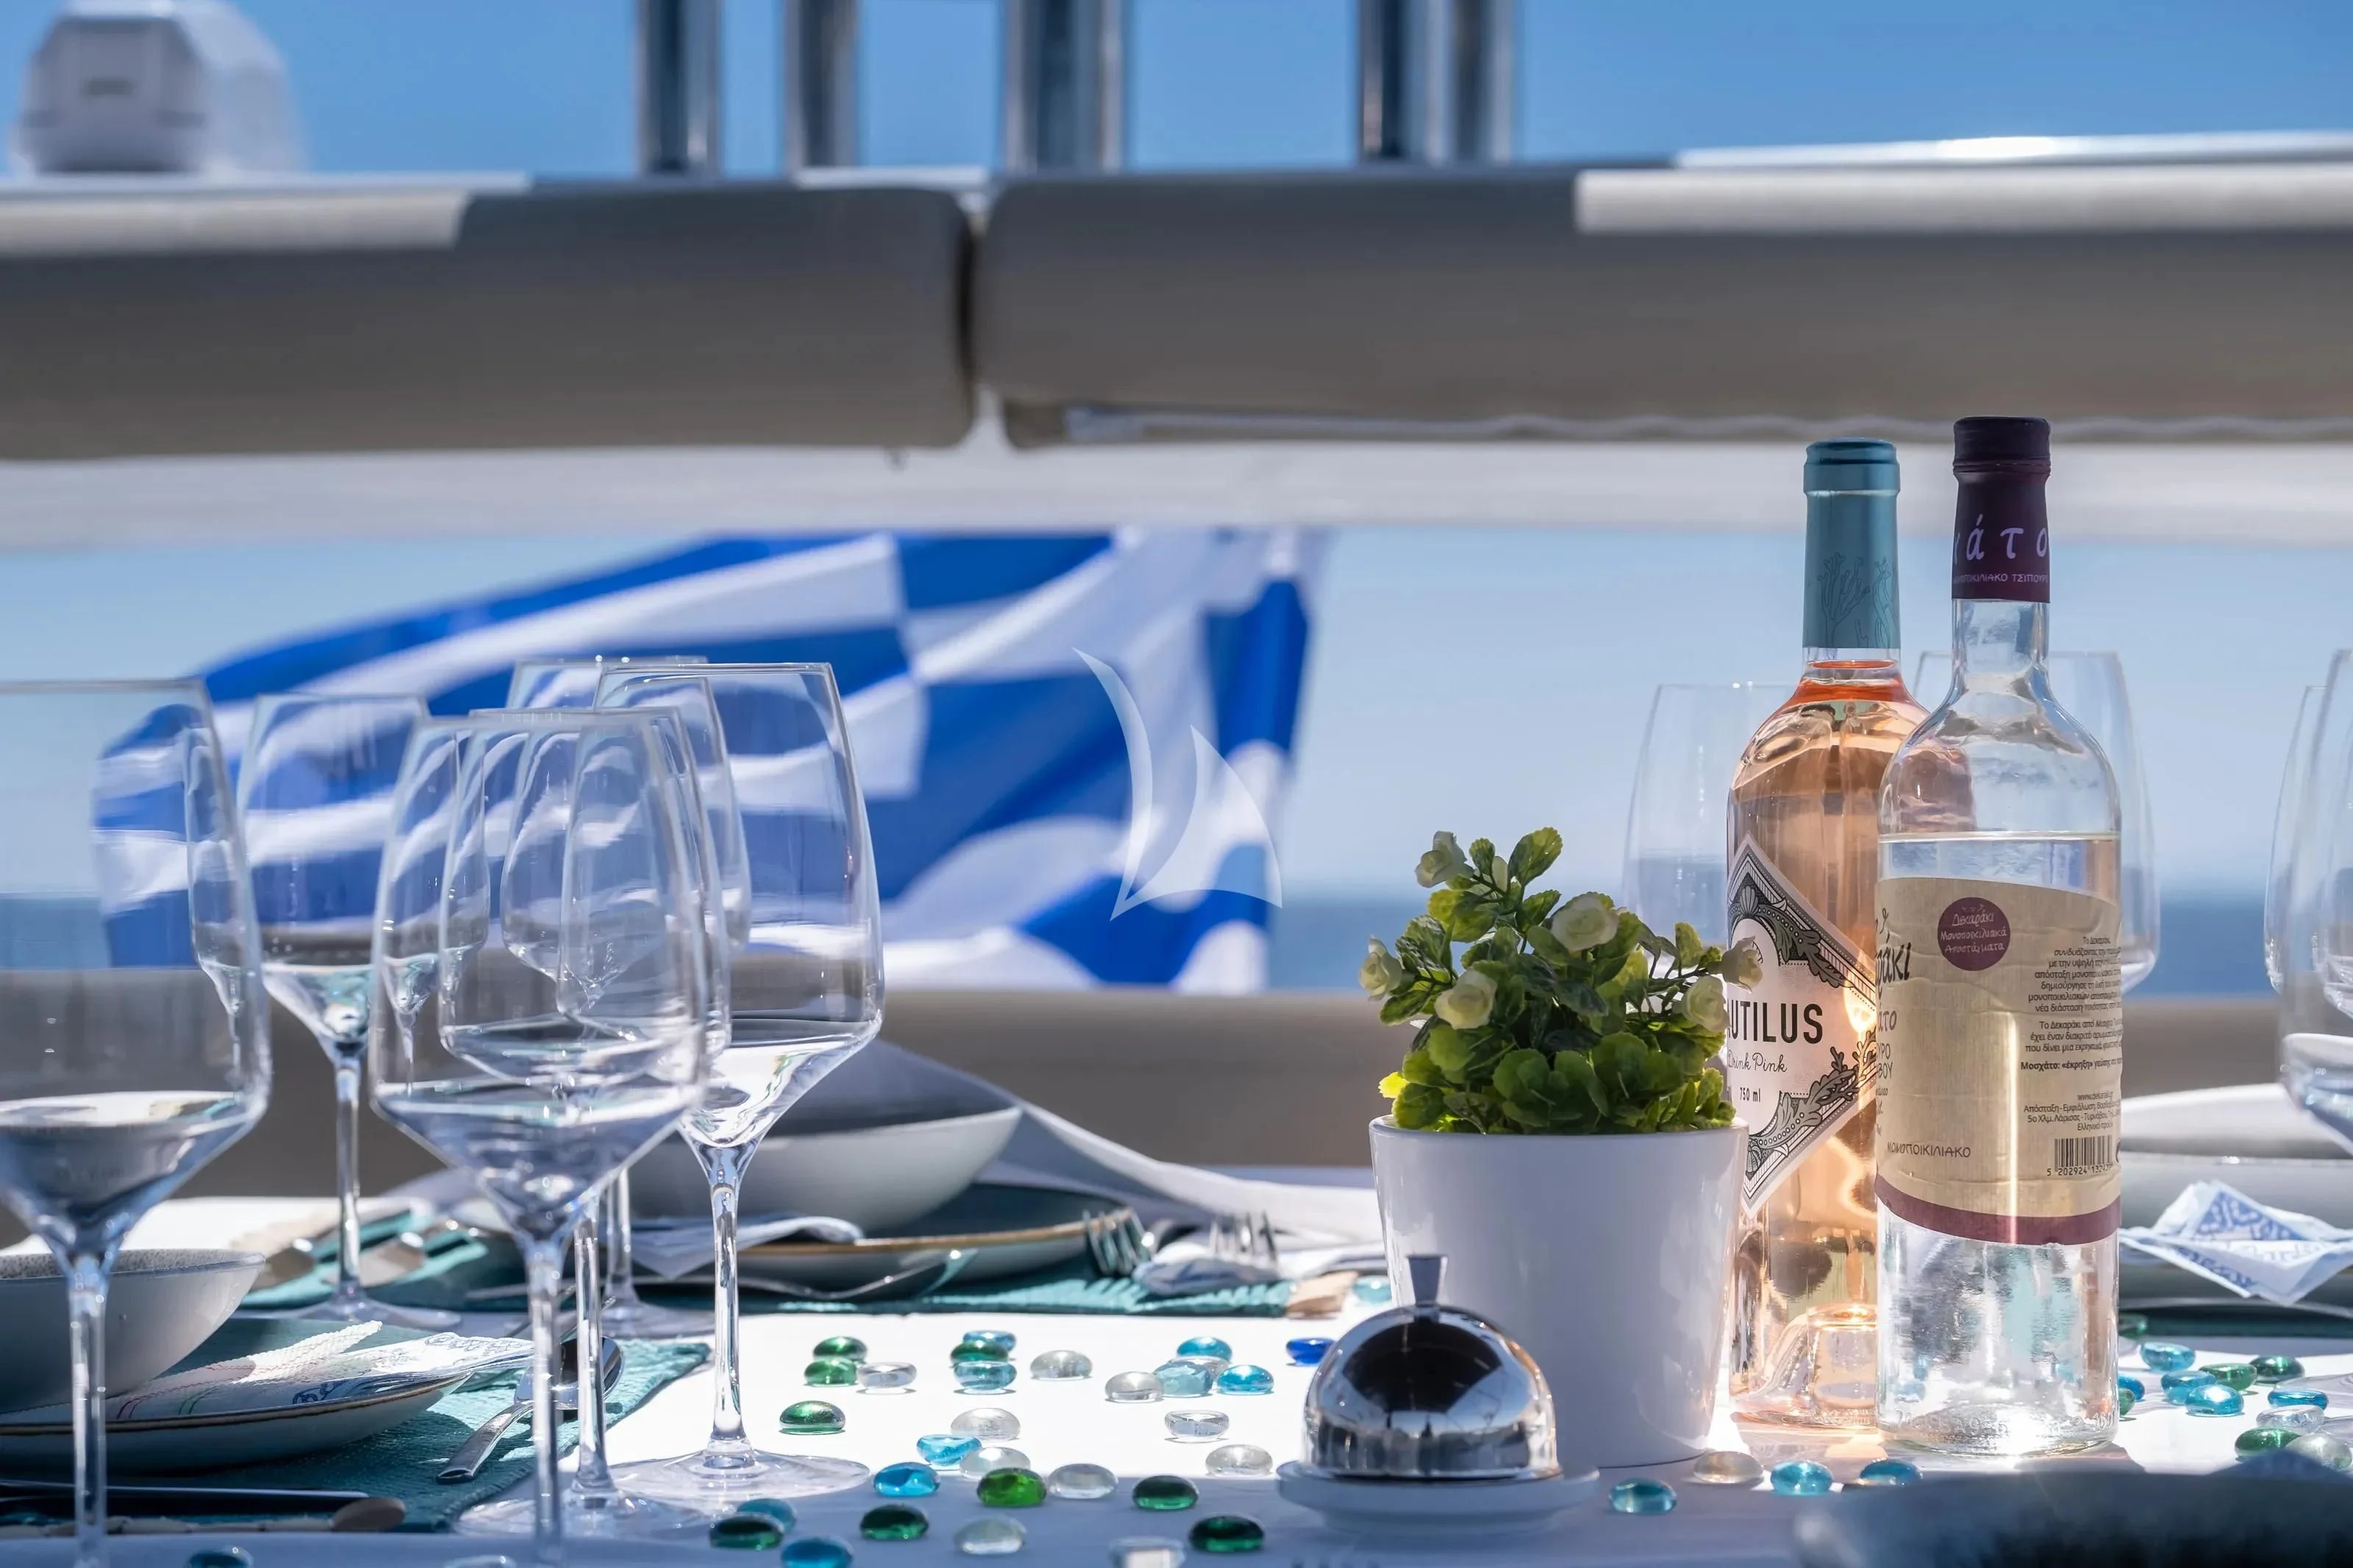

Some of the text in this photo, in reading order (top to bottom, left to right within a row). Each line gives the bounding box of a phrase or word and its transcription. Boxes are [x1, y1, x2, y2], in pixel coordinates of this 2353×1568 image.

[1952, 909, 1995, 926] Δεκαράκι
[1941, 926, 2007, 941] Μονοποικιλιακά
[1945, 942, 2004, 953] Αποστάγματα
[2049, 960, 2057, 968] με
[2058, 960, 2071, 968] την
[2072, 958, 2094, 968] υψηλή
[2035, 970, 2071, 980] απόσταξη
[2040, 981, 2087, 991] δημιούργησε
[2035, 1004, 2049, 1012] νέα
[2050, 1003, 2083, 1013] διάσταση
[2039, 1021, 2049, 1029] Το
[2051, 1020, 2081, 1030] Δεκαράκι
[2030, 1032, 2046, 1042] έχει
[2047, 1031, 2064, 1041] έναν
[2043, 1044, 2060, 1052] δίνει
[2062, 1045, 2074, 1053] μια
[1752, 1052, 1788, 1073] Pink
[2021, 1061, 2060, 1072] Μοσχάτο:
[2061, 1060, 2093, 1070] «έκρηξη»
[1740, 1087, 1750, 1100] 750
[1753, 1088, 1761, 1102] ml
[2024, 1104, 2059, 1113] Απόσταξη
[1887, 1141, 1971, 1158] ΜΟΝΟΠΟΙΚΙΛΙΑΚΟ
[2046, 1168, 2052, 1176] 5
[2058, 1167, 2087, 1176] 202924
